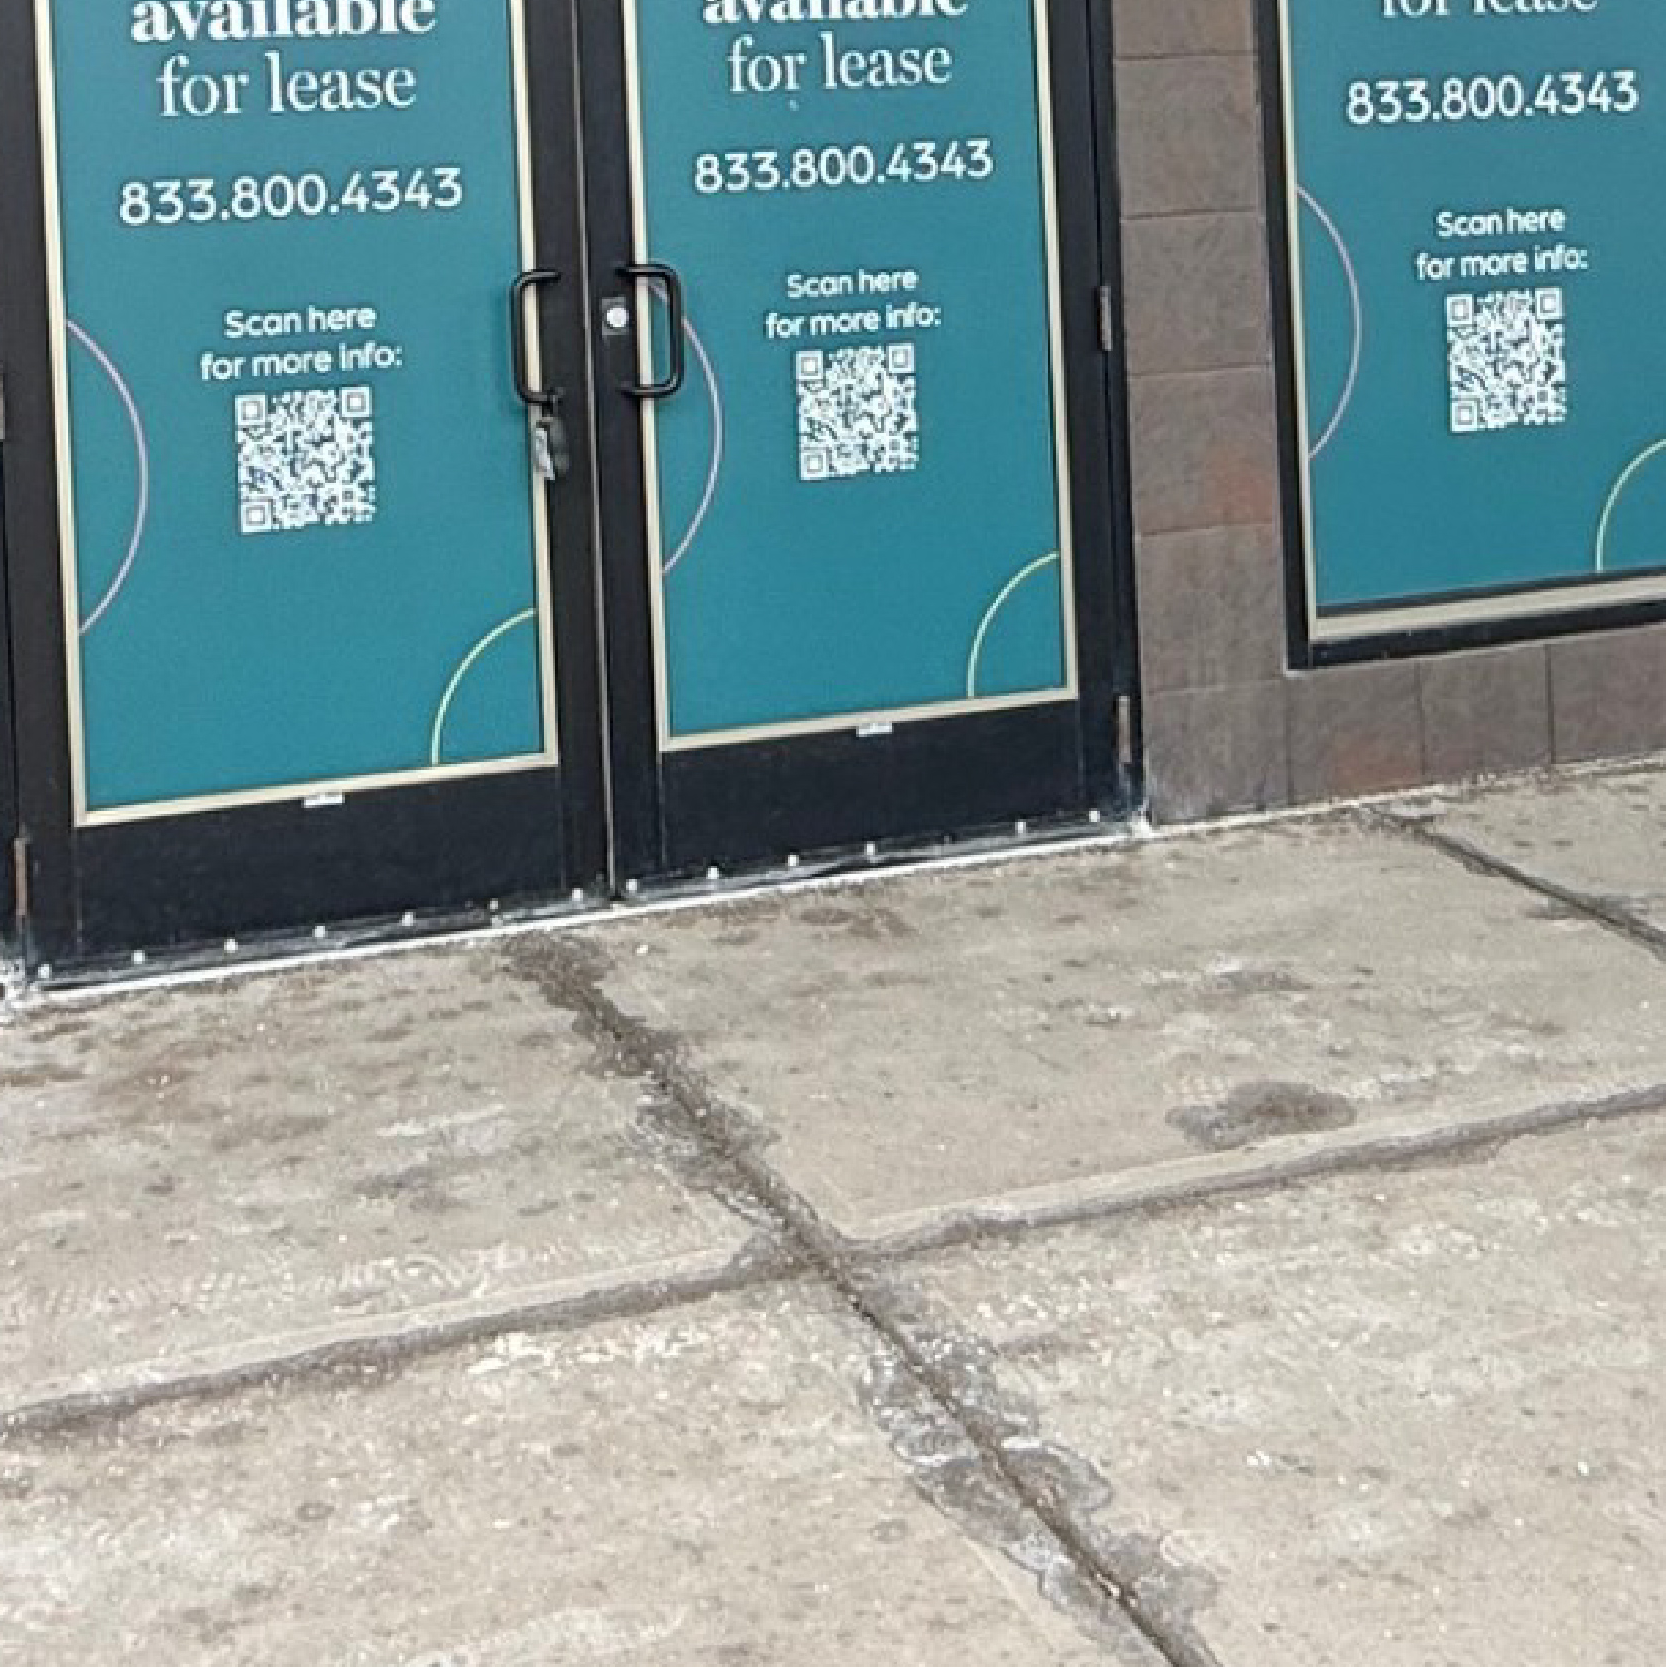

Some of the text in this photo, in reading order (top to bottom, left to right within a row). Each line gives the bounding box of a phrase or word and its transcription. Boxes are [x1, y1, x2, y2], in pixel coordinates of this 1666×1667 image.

[727, 30, 952, 92] for lease
[155, 49, 417, 117] for lease
[1348, 69, 1640, 125] 833.800.4343
[694, 137, 994, 194] 833.800.4343
[119, 167, 463, 227] 833.800.4343
[1436, 208, 1566, 237] Scan here
[1416, 242, 1588, 281] for more info:
[788, 268, 920, 298] Scan here
[224, 305, 376, 339] Scan here
[765, 301, 942, 339] for more info:
[199, 339, 403, 381] for more info:
